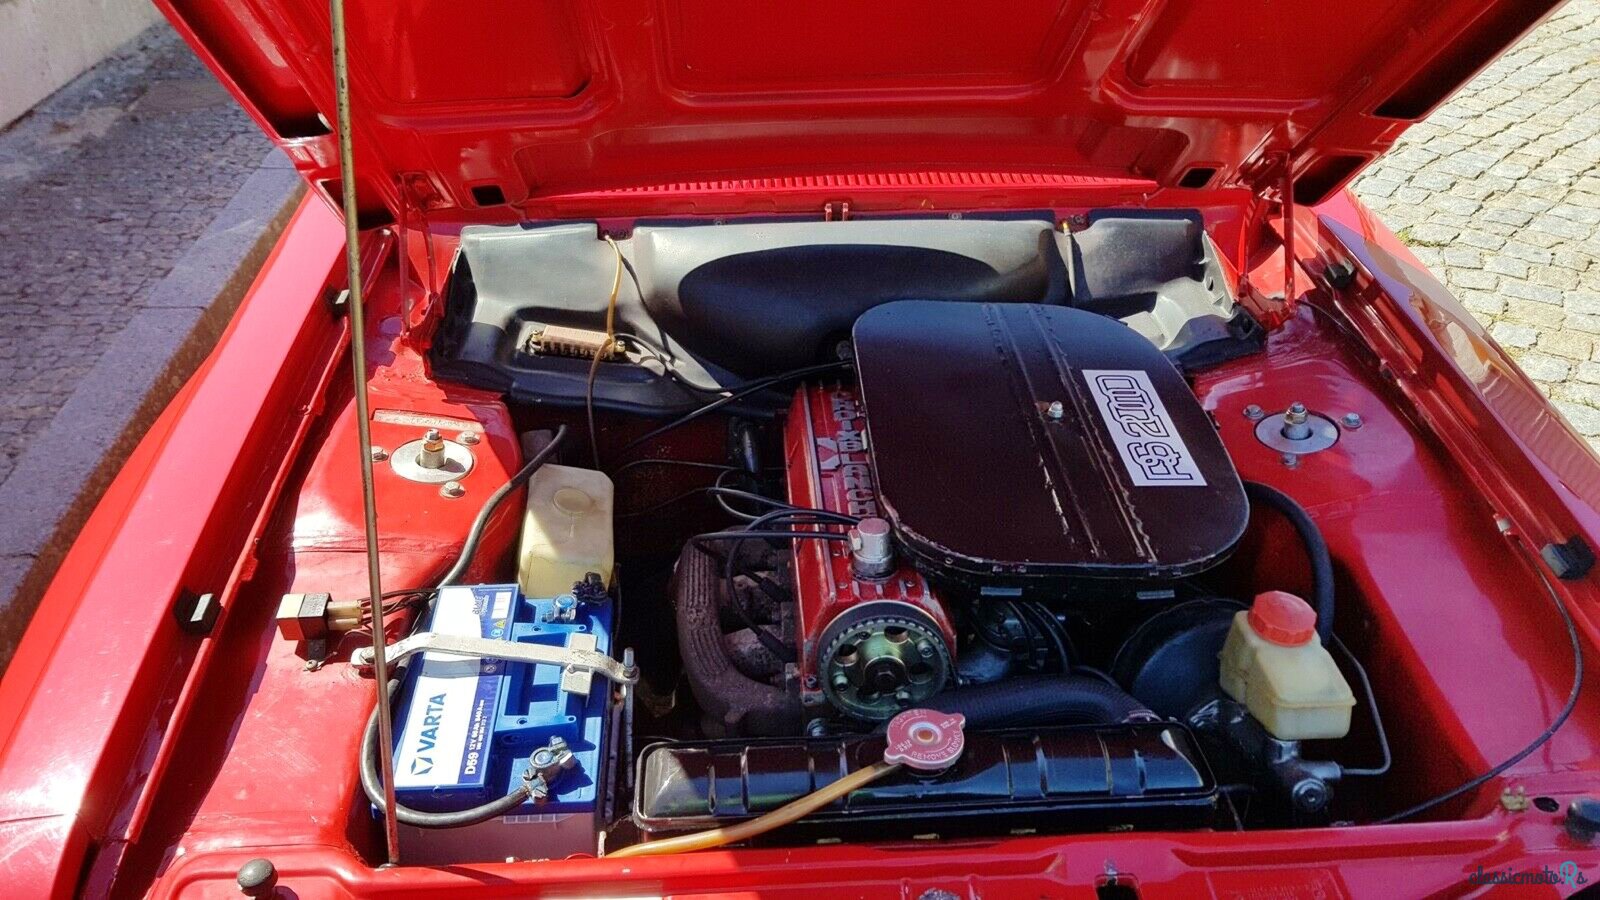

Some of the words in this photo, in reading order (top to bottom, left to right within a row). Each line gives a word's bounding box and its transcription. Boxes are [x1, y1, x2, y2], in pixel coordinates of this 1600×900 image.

[416, 692, 447, 754] VARTA
[464, 751, 480, 775] D59
[911, 750, 948, 760] REMOVE
